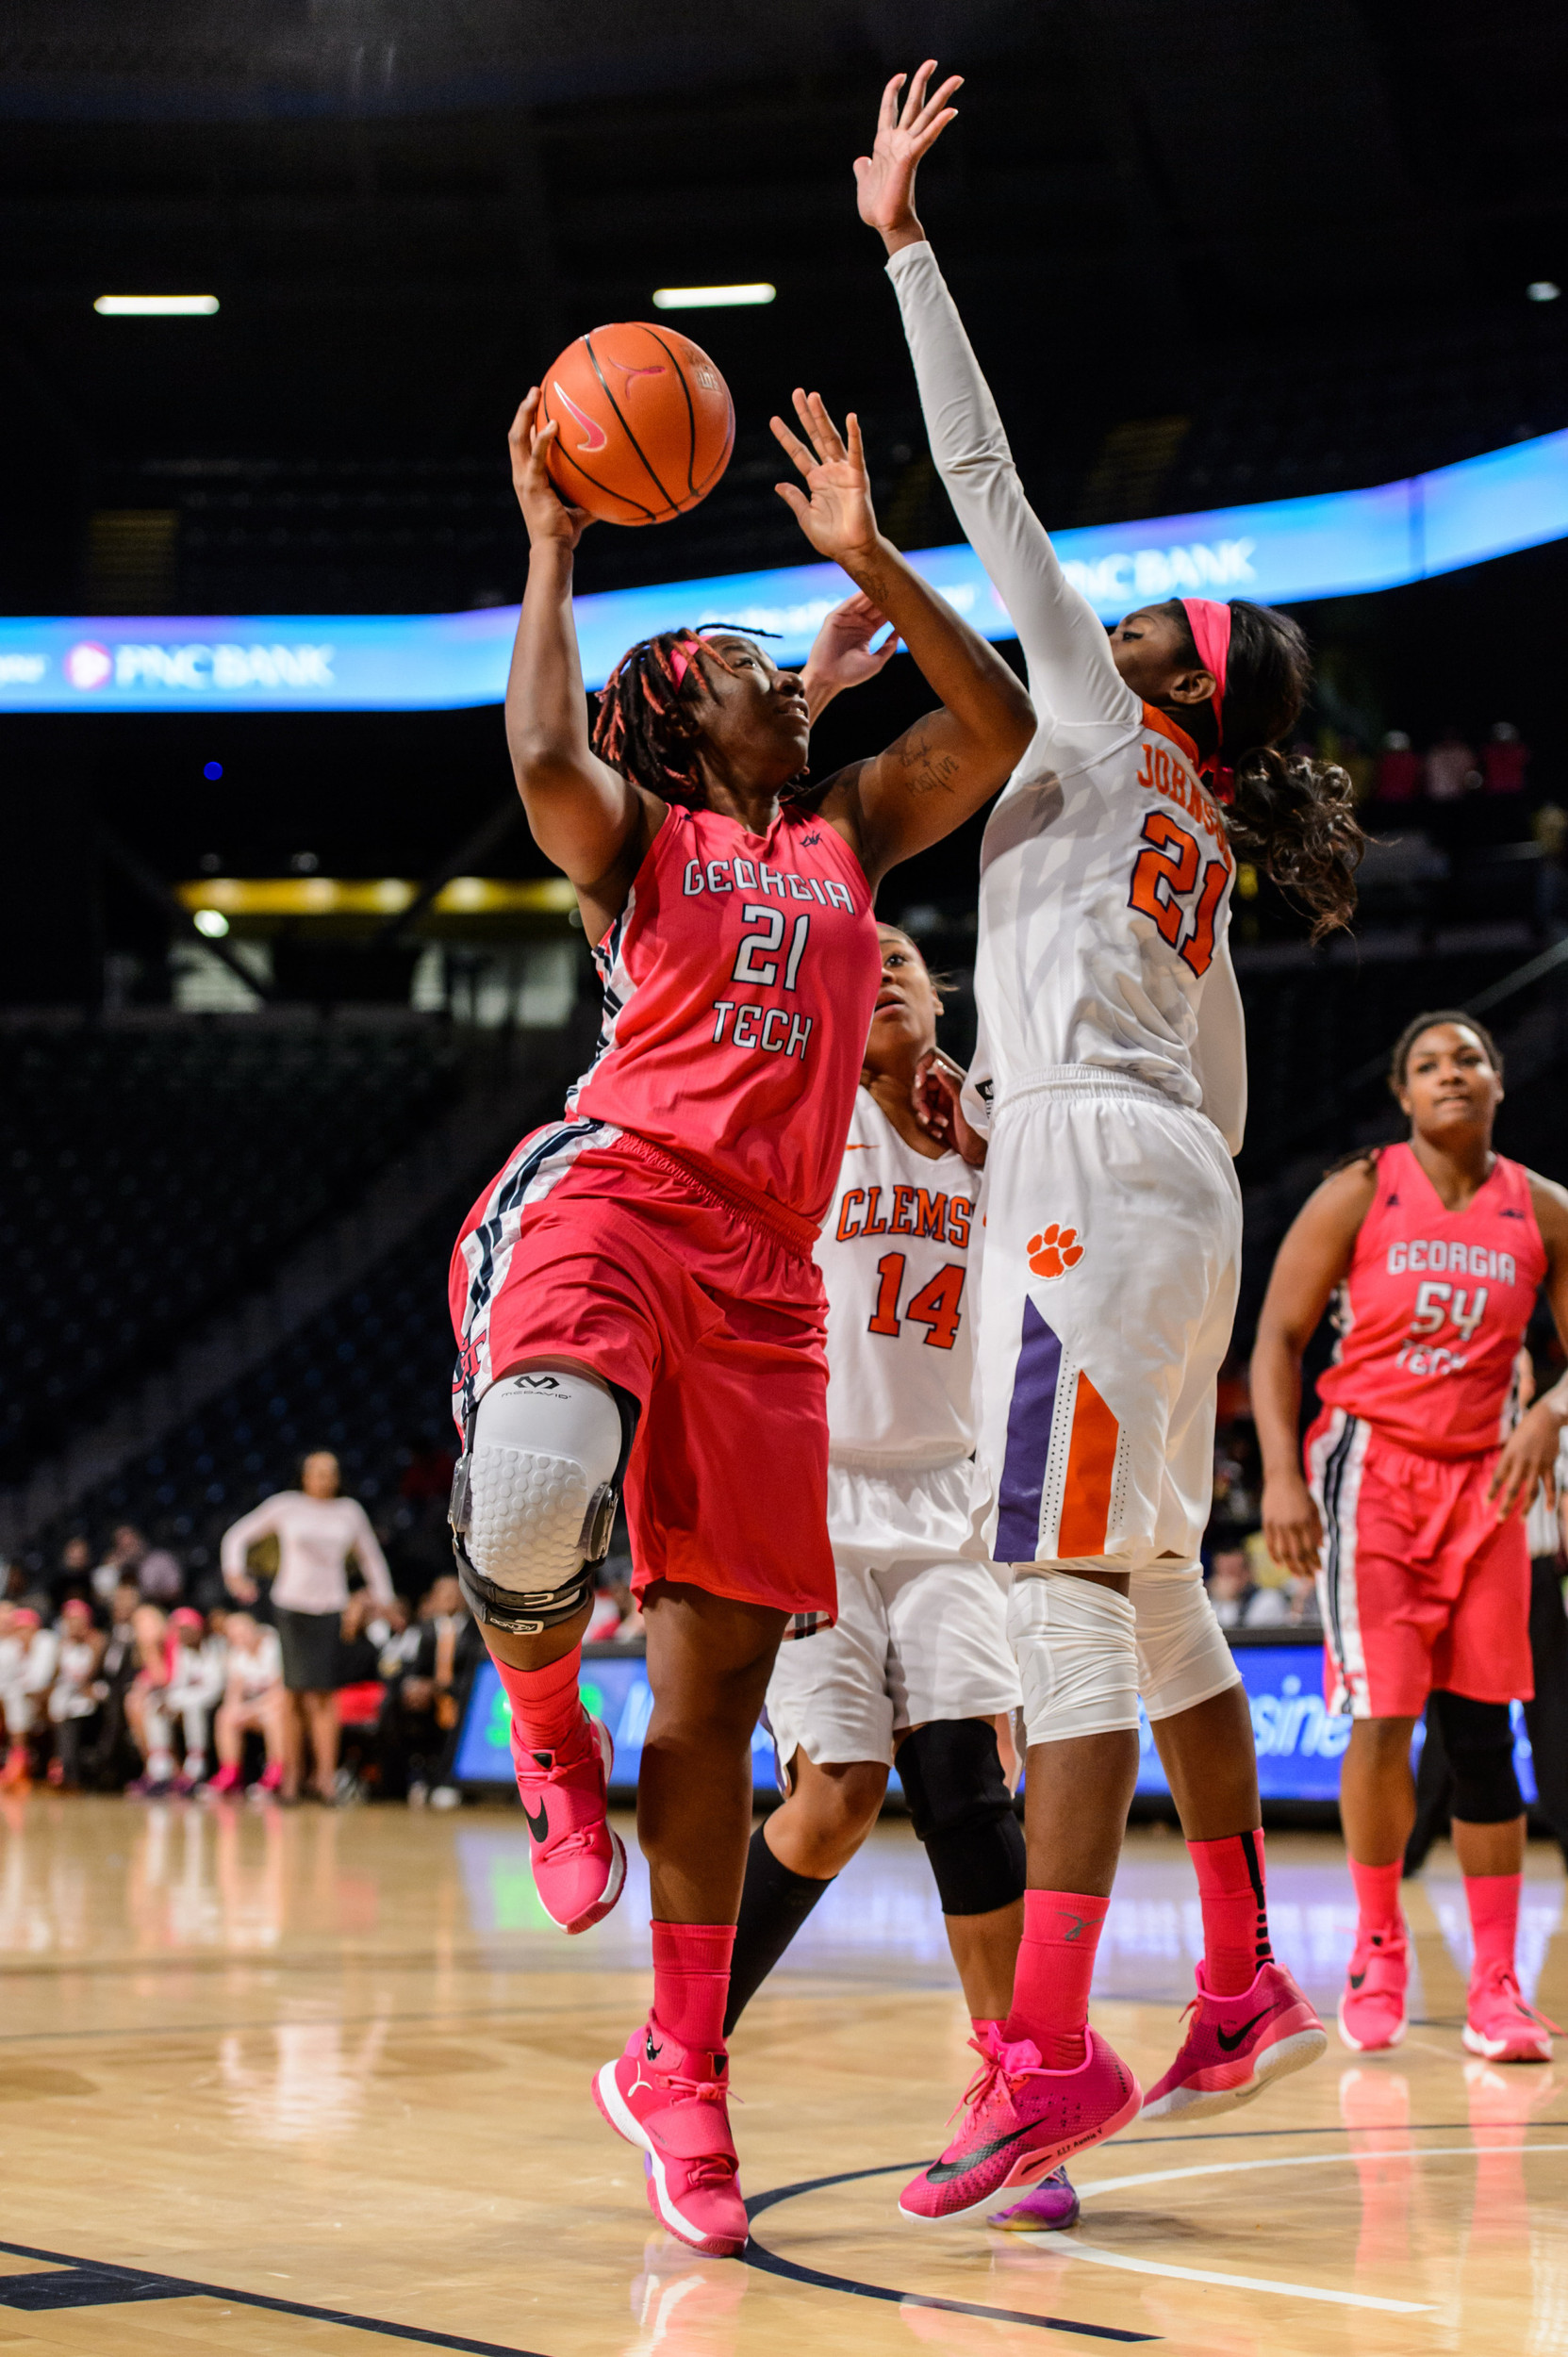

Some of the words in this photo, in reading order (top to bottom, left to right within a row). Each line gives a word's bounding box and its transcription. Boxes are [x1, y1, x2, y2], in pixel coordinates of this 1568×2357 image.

[1058, 551, 1133, 601] NC
[1134, 537, 1257, 596] BANK
[115, 644, 211, 689] PNC
[211, 644, 335, 688] BANK
[683, 857, 855, 915] GEORGIA
[1127, 810, 1230, 980] 21
[732, 904, 810, 992] 21
[712, 1000, 812, 1060] TECH
[836, 1184, 976, 1249] CLEMS
[1387, 1240, 1516, 1286] GEORGIA
[867, 1251, 966, 1350] 14
[1411, 1280, 1489, 1342] 54
[1250, 1674, 1353, 1757] sine
